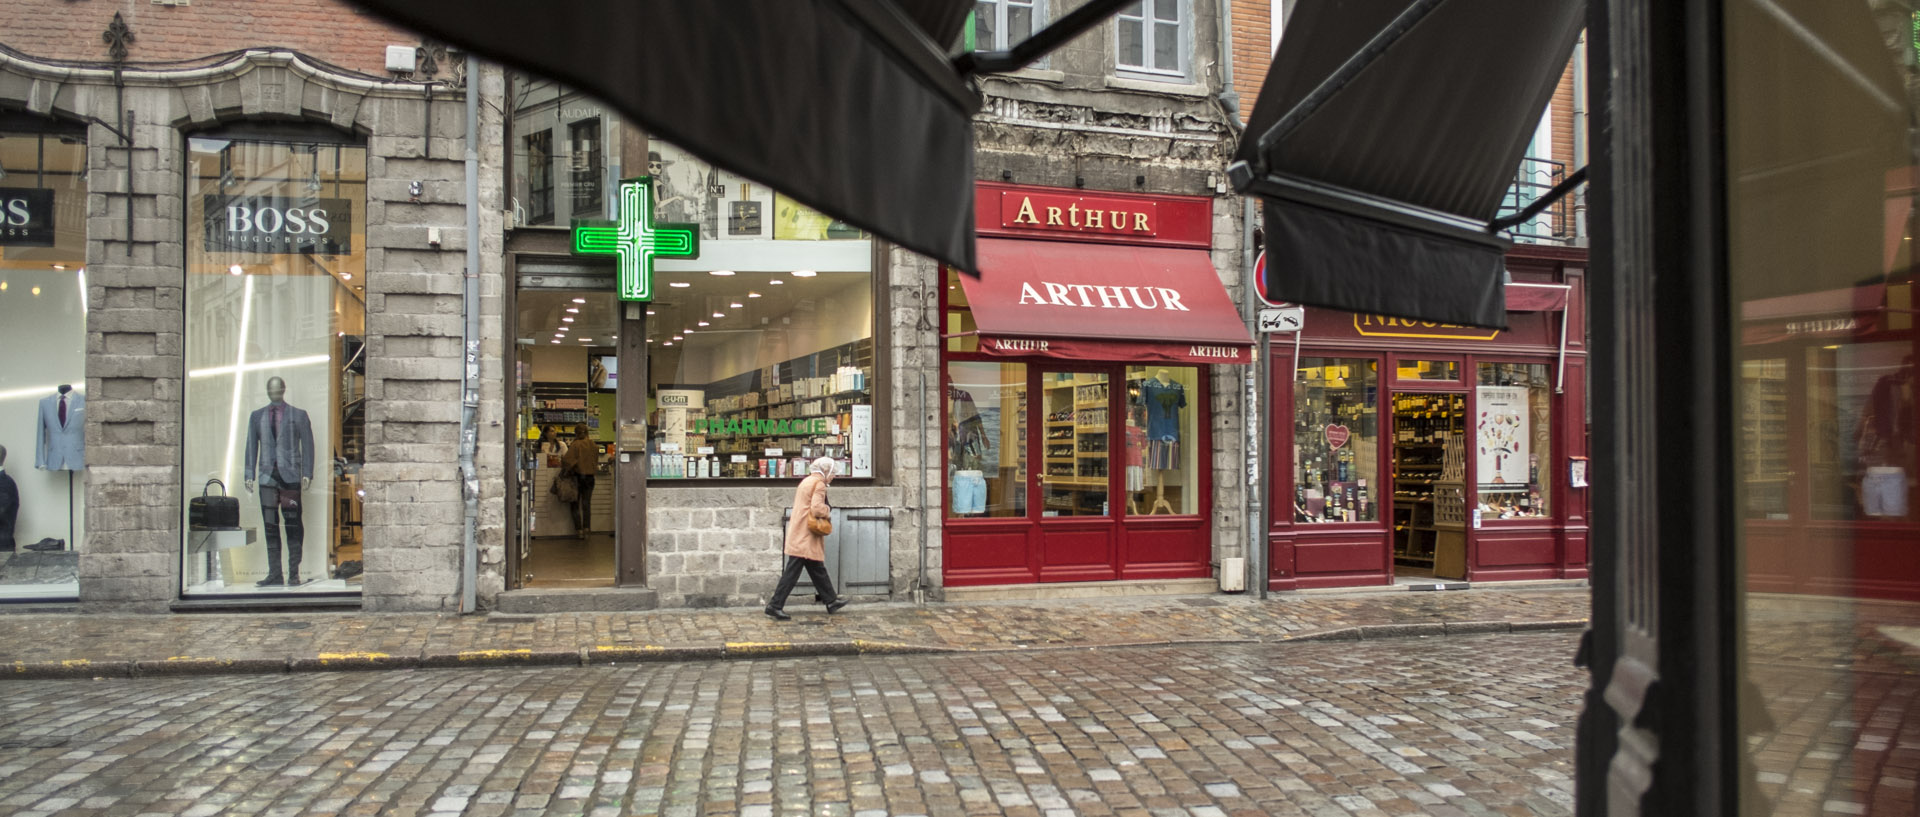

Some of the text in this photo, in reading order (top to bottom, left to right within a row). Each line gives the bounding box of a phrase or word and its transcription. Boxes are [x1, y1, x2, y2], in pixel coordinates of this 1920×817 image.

[227, 206, 329, 235] BOSS
[1018, 281, 1190, 311] ARTHUR
[994, 338, 1049, 352] ARTHUR
[1188, 345, 1239, 359] ARTHUR
[694, 418, 827, 435] PHARMACIE
